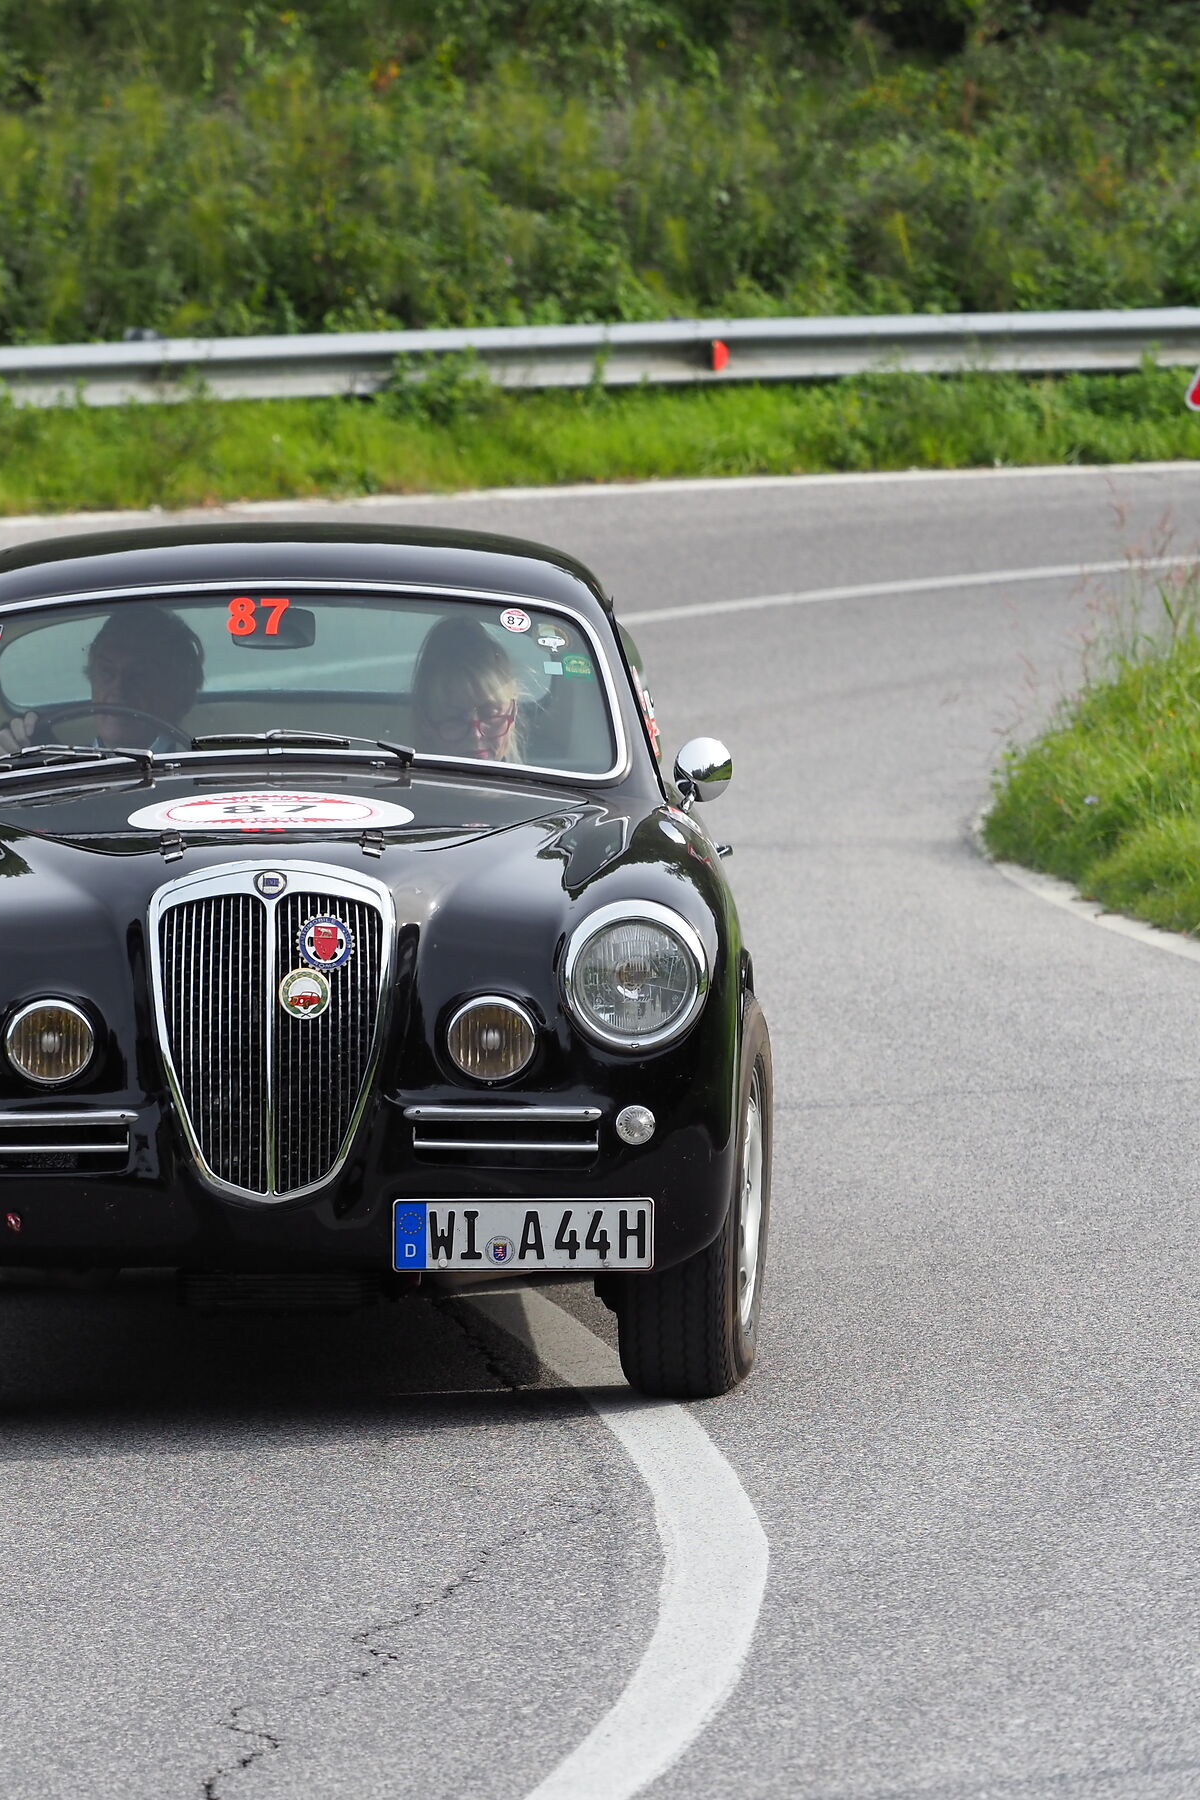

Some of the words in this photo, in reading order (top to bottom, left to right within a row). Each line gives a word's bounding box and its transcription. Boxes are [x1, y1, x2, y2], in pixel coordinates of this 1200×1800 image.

[227, 597, 290, 636] 87
[507, 615, 525, 627] 87
[222, 804, 318, 814] 87
[313, 960, 337, 969] ROMA
[428, 1210, 483, 1260] WI
[404, 1243, 417, 1258] D
